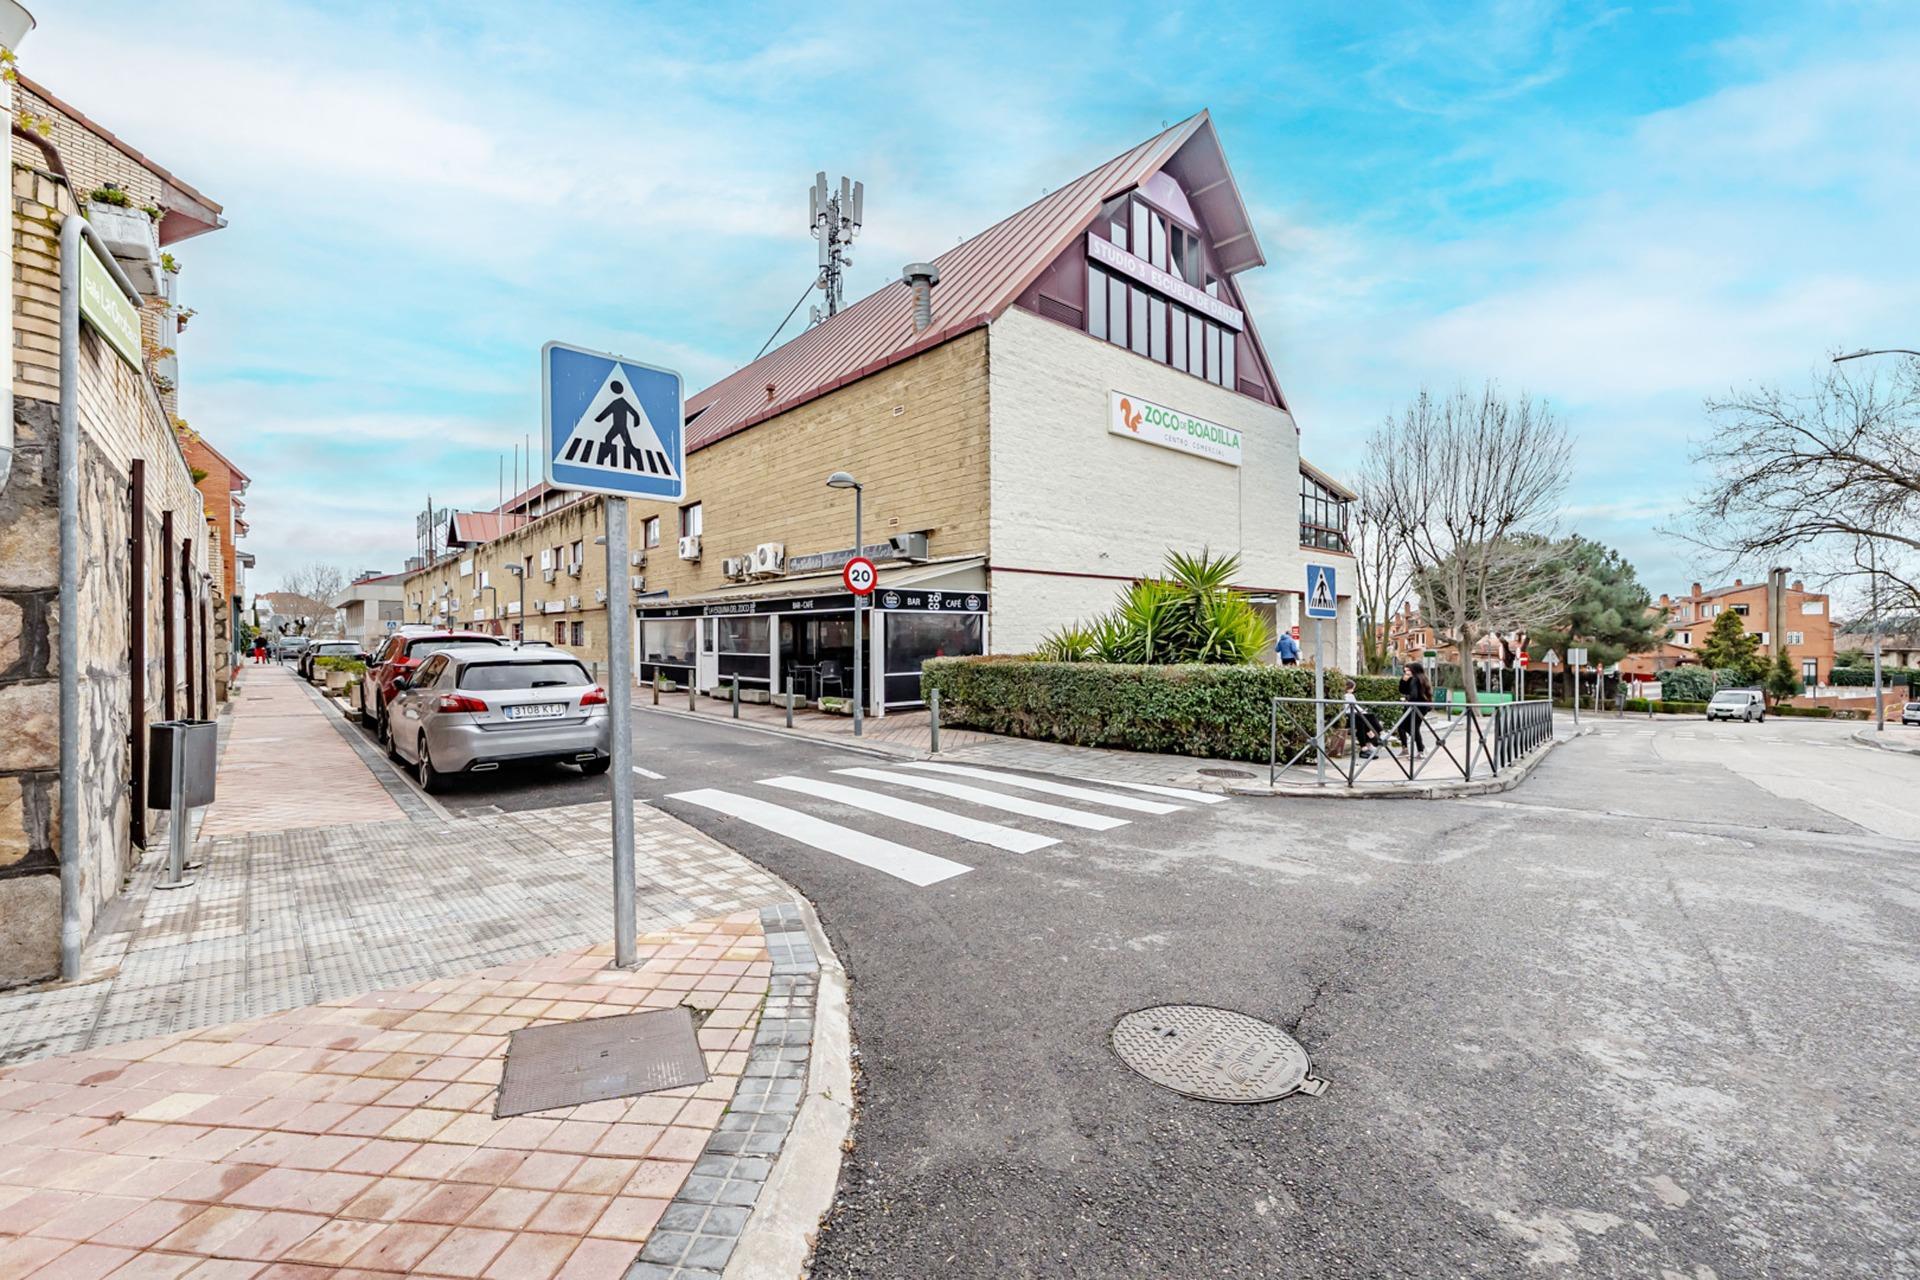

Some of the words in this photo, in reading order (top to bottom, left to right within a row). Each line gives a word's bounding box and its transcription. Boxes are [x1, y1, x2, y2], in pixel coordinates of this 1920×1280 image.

[1093, 240, 1136, 271] STUDIO
[1151, 271, 1195, 303] ESCUELA
[1197, 297, 1209, 310] DE
[1211, 303, 1239, 322] DANZA
[1145, 405, 1180, 431] ZOCO
[1187, 420, 1240, 449] BOADILLA
[1164, 434, 1188, 447] CENTRO
[1192, 443, 1225, 457] COMERCIAL
[851, 569, 870, 582] 20
[907, 597, 921, 606] BAR
[945, 598, 962, 608] CAFÉ
[514, 705, 540, 715] 3108
[542, 703, 561, 713] KTJ
